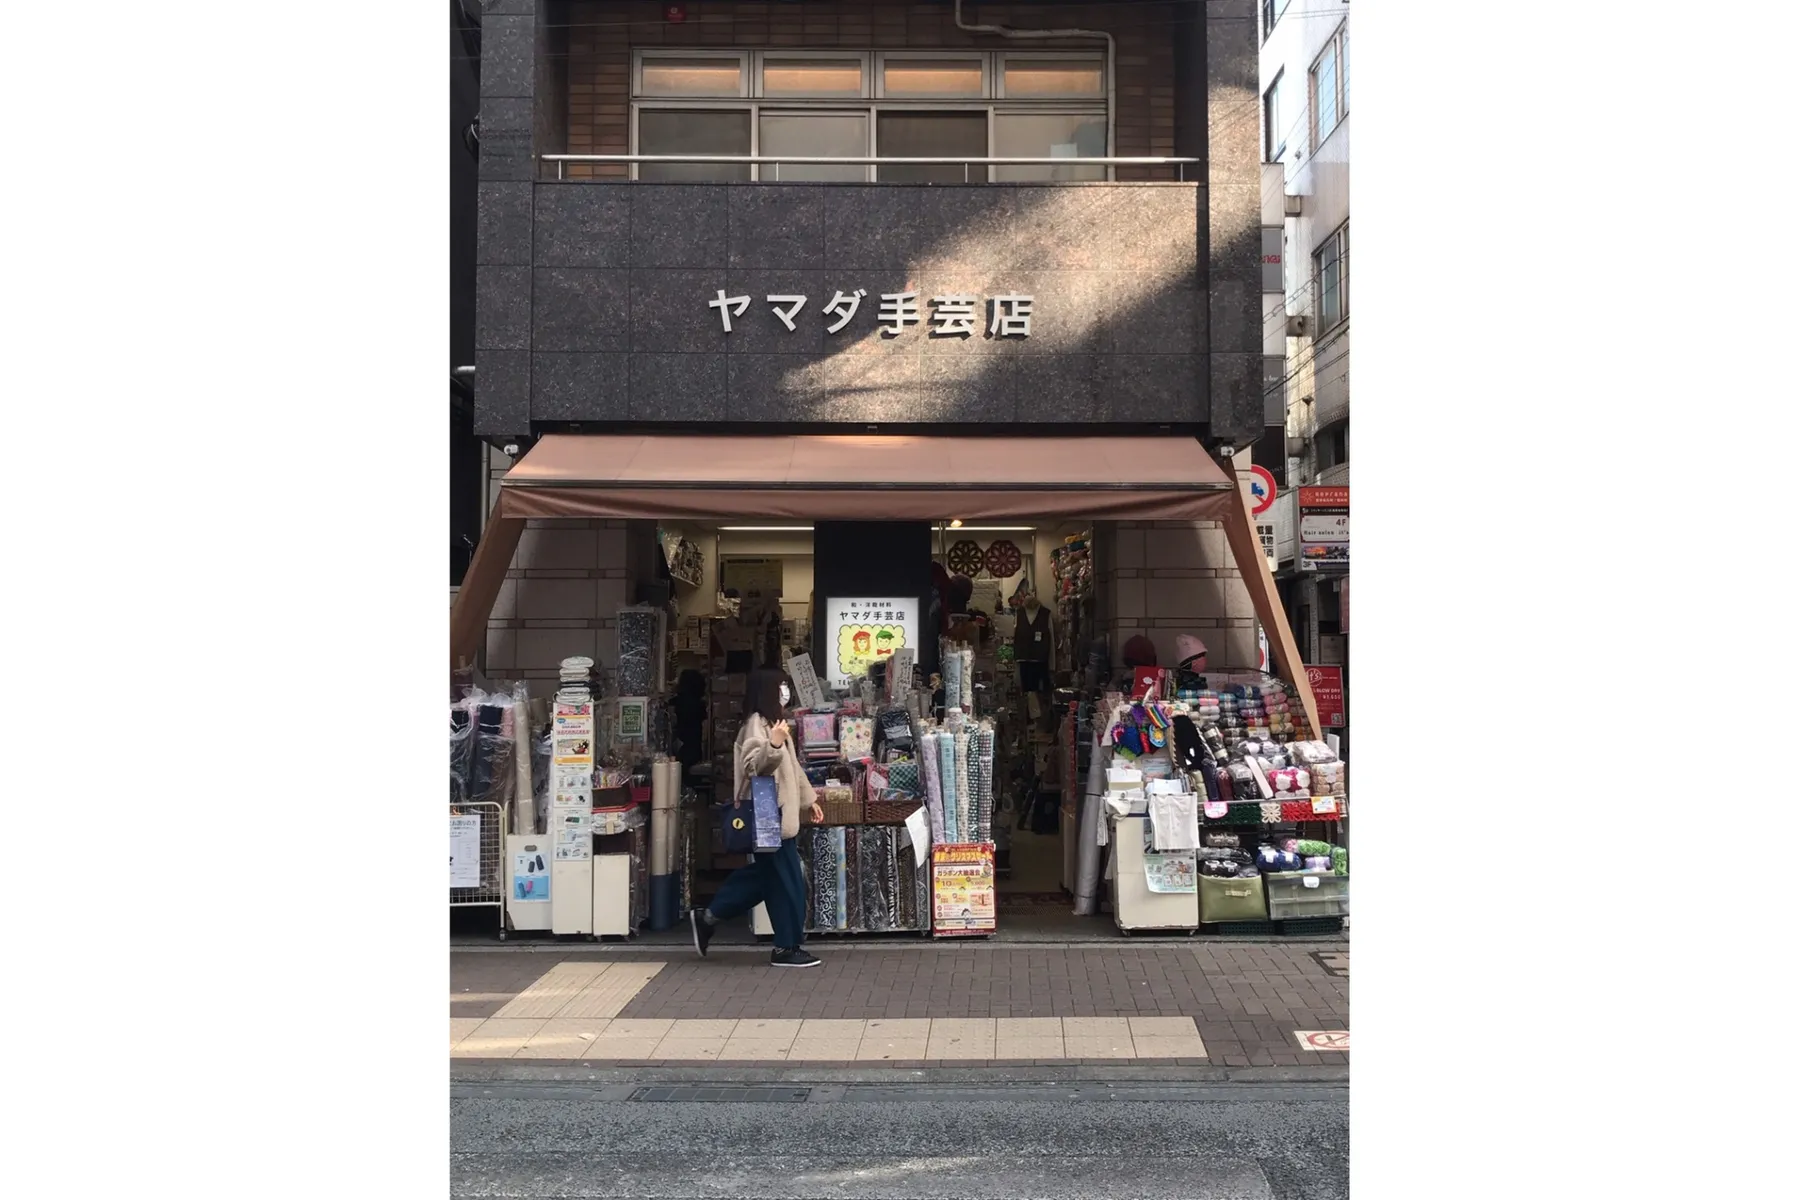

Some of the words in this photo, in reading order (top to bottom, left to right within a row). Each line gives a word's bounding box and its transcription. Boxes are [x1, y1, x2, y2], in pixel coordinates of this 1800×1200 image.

[709, 289, 1034, 336] ヤマダ手芸店
[839, 611, 905, 621] ヤマダ手芸店
